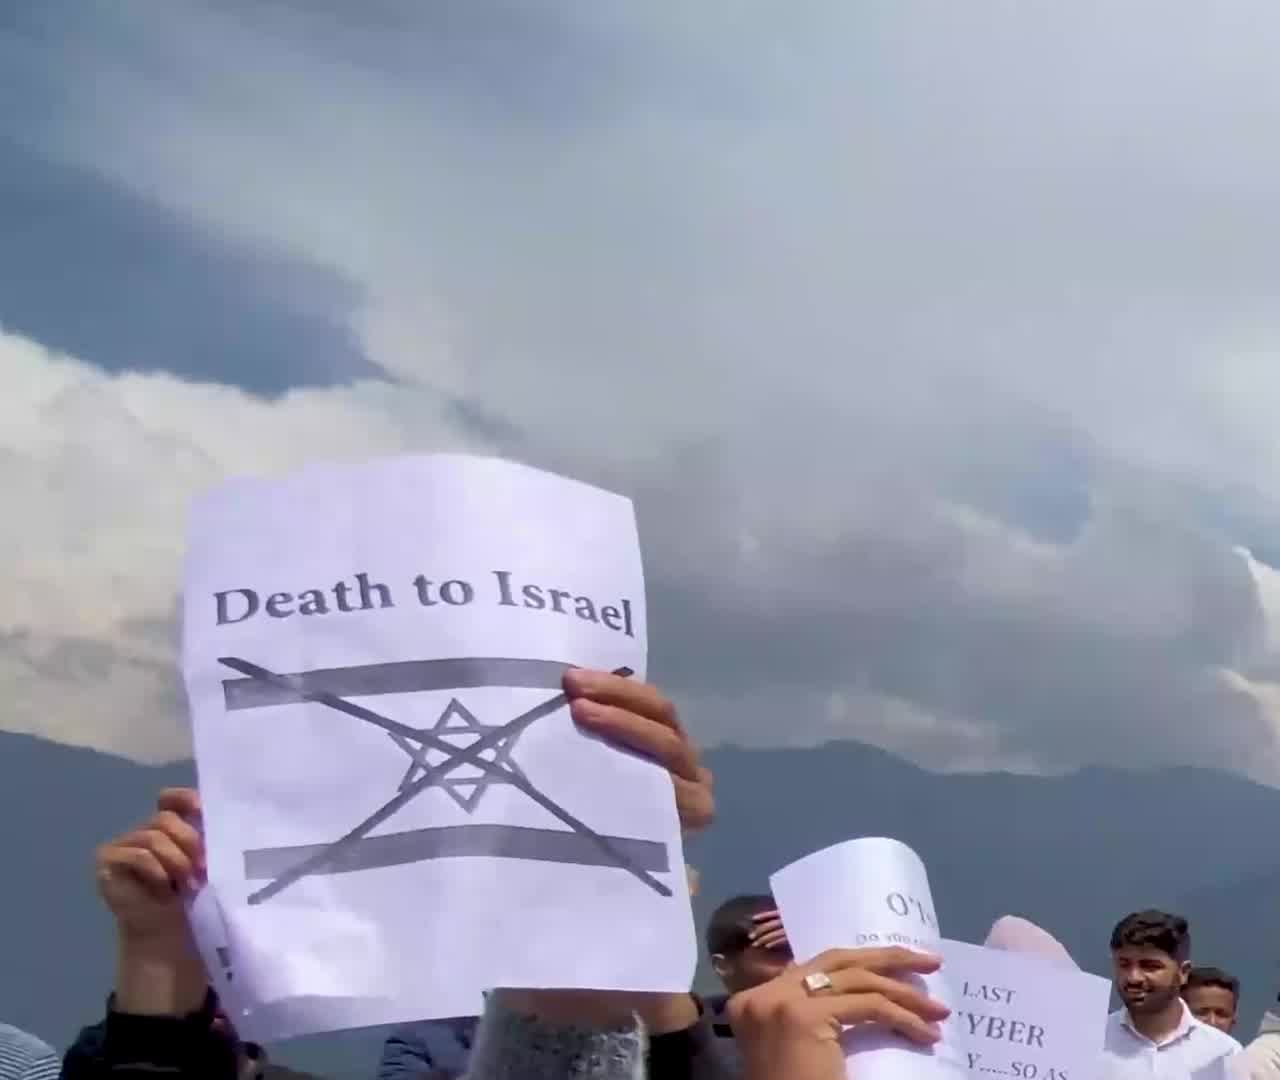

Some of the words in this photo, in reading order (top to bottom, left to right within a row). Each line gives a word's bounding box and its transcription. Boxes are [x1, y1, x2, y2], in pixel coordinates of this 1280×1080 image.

[213, 571, 393, 626] Death
[412, 573, 474, 607] to
[492, 570, 635, 638] Israel
[962, 981, 1017, 1005] LAST
[958, 1011, 1045, 1048] YBER
